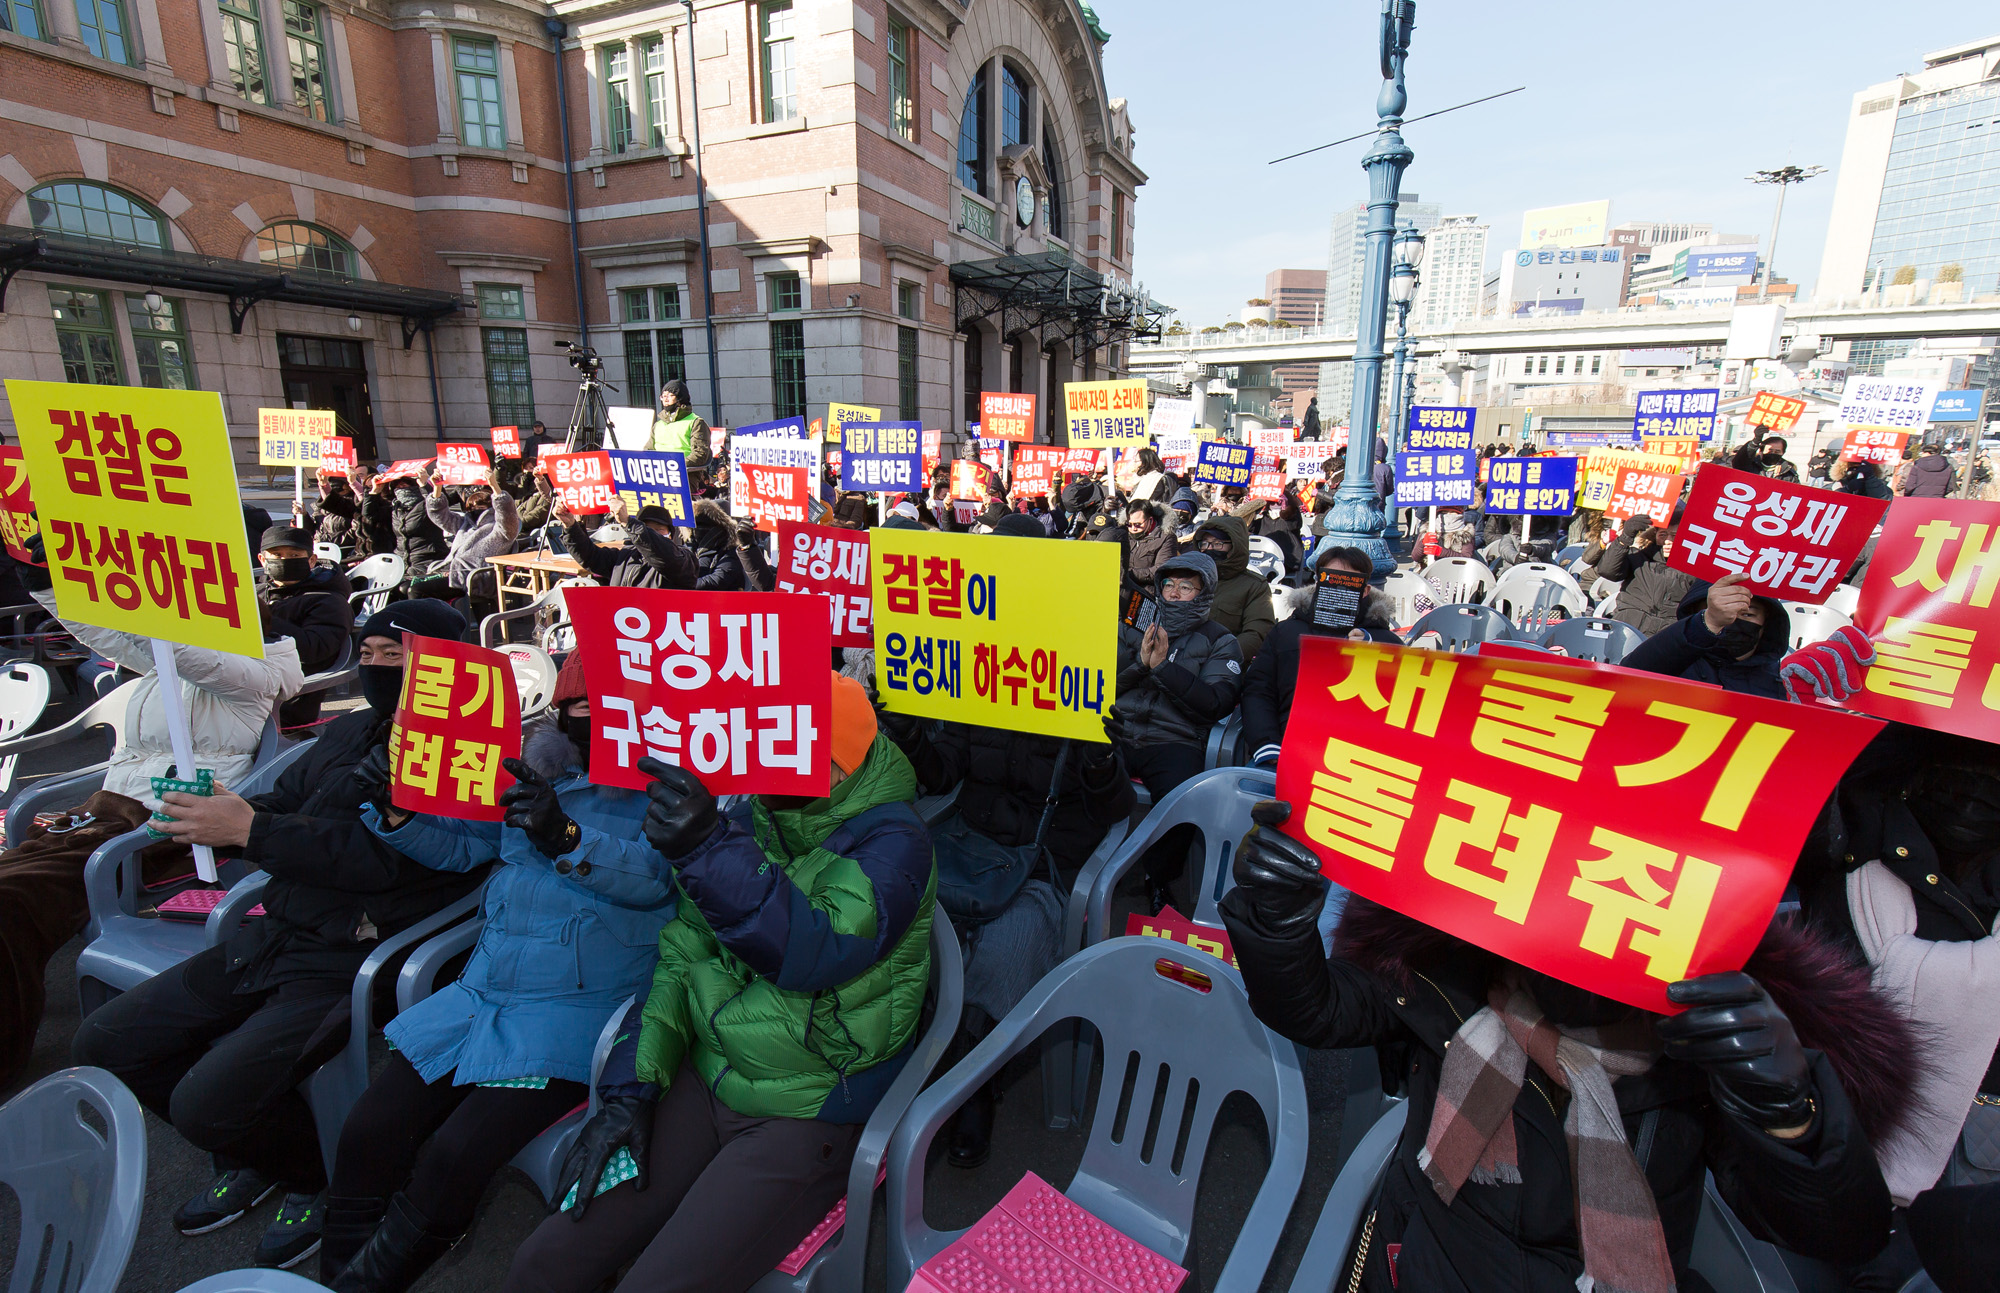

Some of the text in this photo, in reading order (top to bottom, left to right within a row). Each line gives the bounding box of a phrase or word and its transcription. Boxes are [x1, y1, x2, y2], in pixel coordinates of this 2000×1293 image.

[1538, 250, 1619, 264] 한진택배
[1714, 256, 1746, 266] BASF
[1068, 387, 1143, 412] 피해자의 소리에
[1682, 393, 1716, 413] 윤성재를
[1855, 383, 1891, 401] 윤성재와
[1894, 385, 1924, 404] 최호영
[1936, 399, 1964, 408] 서울역
[1756, 395, 1802, 416] 채굴기
[1841, 405, 1925, 427] 부장검사는 무슨관계
[263, 415, 332, 436] 힘들어서 못 살겠다
[989, 417, 1026, 437] 책임져라
[1071, 417, 1145, 439] 귀를 기울여달라
[1418, 409, 1467, 428] 부장검사
[1636, 417, 1712, 438] 구속수사하라
[1749, 409, 1794, 431] 돌려줘
[321, 439, 343, 455] 성재
[844, 428, 874, 454] 채굴기
[877, 428, 917, 454] 불법점유
[1260, 432, 1284, 443] 윤성재를
[1410, 430, 1471, 449] 정신차려라
[1647, 441, 1693, 455] 채굴기
[1855, 430, 1899, 446] 윤성재
[48, 409, 192, 506] 검찰은
[265, 440, 295, 459] 채굴기
[445, 447, 481, 463] 윤성재
[1066, 448, 1093, 461] 윤성재
[1206, 445, 1229, 463] 윤성재를
[1290, 445, 1334, 458] 채굴기 도둑
[1844, 445, 1900, 464] 구속하라
[556, 457, 601, 483] 윤성재
[1016, 463, 1042, 478] 윤성재
[1061, 460, 1095, 474] 구속하라
[1254, 455, 1275, 466] 윤성재
[1406, 456, 1432, 476] 도둑
[1436, 454, 1464, 475] 비호
[440, 465, 487, 481] 구속하라
[627, 458, 682, 488] 이더리움
[1254, 474, 1280, 486] 윤성재
[1492, 462, 1522, 484] 이제
[1526, 462, 1542, 484] 곧
[752, 470, 793, 500] 윤성재
[1013, 480, 1049, 495] 구속하라
[1249, 486, 1282, 498] 구속하라
[1397, 479, 1472, 502] 인천검찰 각성하라
[1582, 480, 1613, 502] 채굴기
[1622, 471, 1670, 498] 윤성재
[1490, 489, 1569, 511] 자살 뿐인가
[1611, 493, 1670, 523] 구속하라
[1713, 481, 1848, 548] 윤성재
[791, 533, 866, 586] 윤성재
[1681, 523, 1840, 596] 구속하라
[50, 519, 241, 629] 각성하라
[883, 553, 996, 621] 검찰이
[614, 607, 781, 690] 윤성재
[885, 632, 1105, 715] 윤성재 하수인이냐
[601, 695, 817, 776] 구속하라
[1327, 646, 1795, 831] 채굴기
[1303, 737, 1723, 983] 돌려줘
